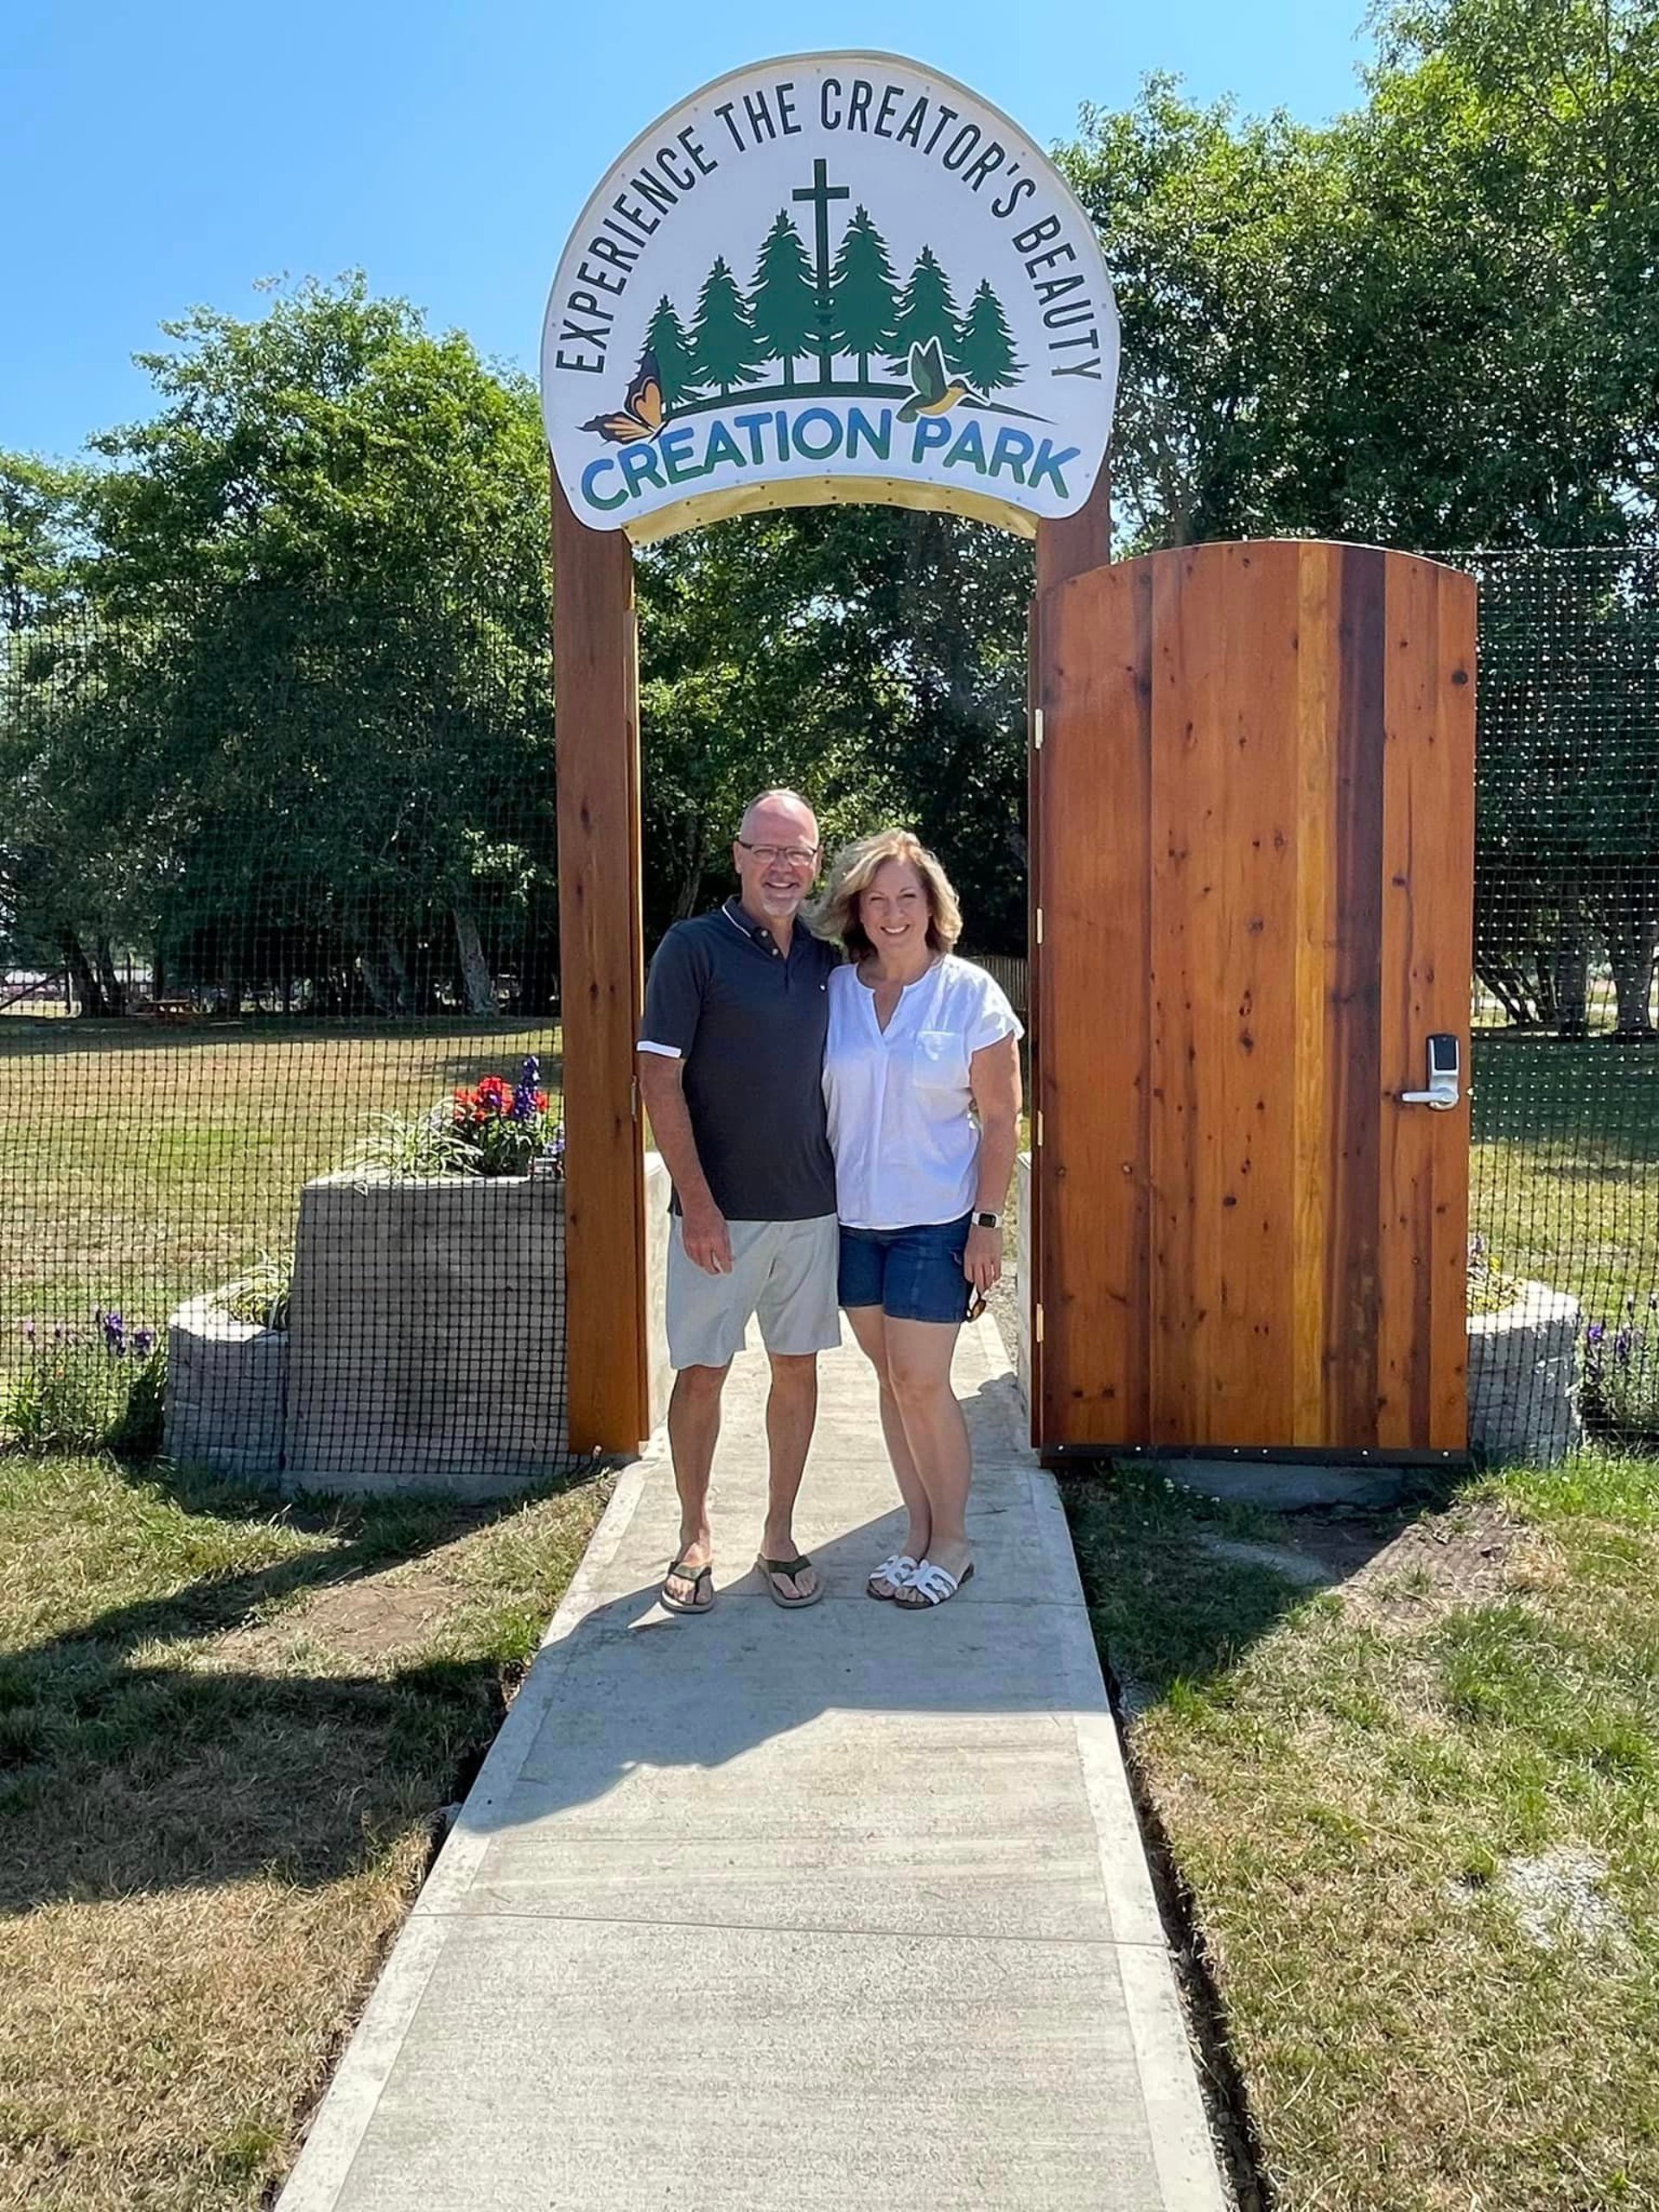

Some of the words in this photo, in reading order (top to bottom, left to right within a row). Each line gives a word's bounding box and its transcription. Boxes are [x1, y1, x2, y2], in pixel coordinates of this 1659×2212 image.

[556, 126, 719, 375] EXPERIENCE
[714, 82, 802, 153] THE
[820, 78, 1035, 219] CREATOR'S
[1012, 213, 1102, 382] BEAUTY
[581, 407, 893, 511] CREATION
[912, 416, 1082, 499] PARK
